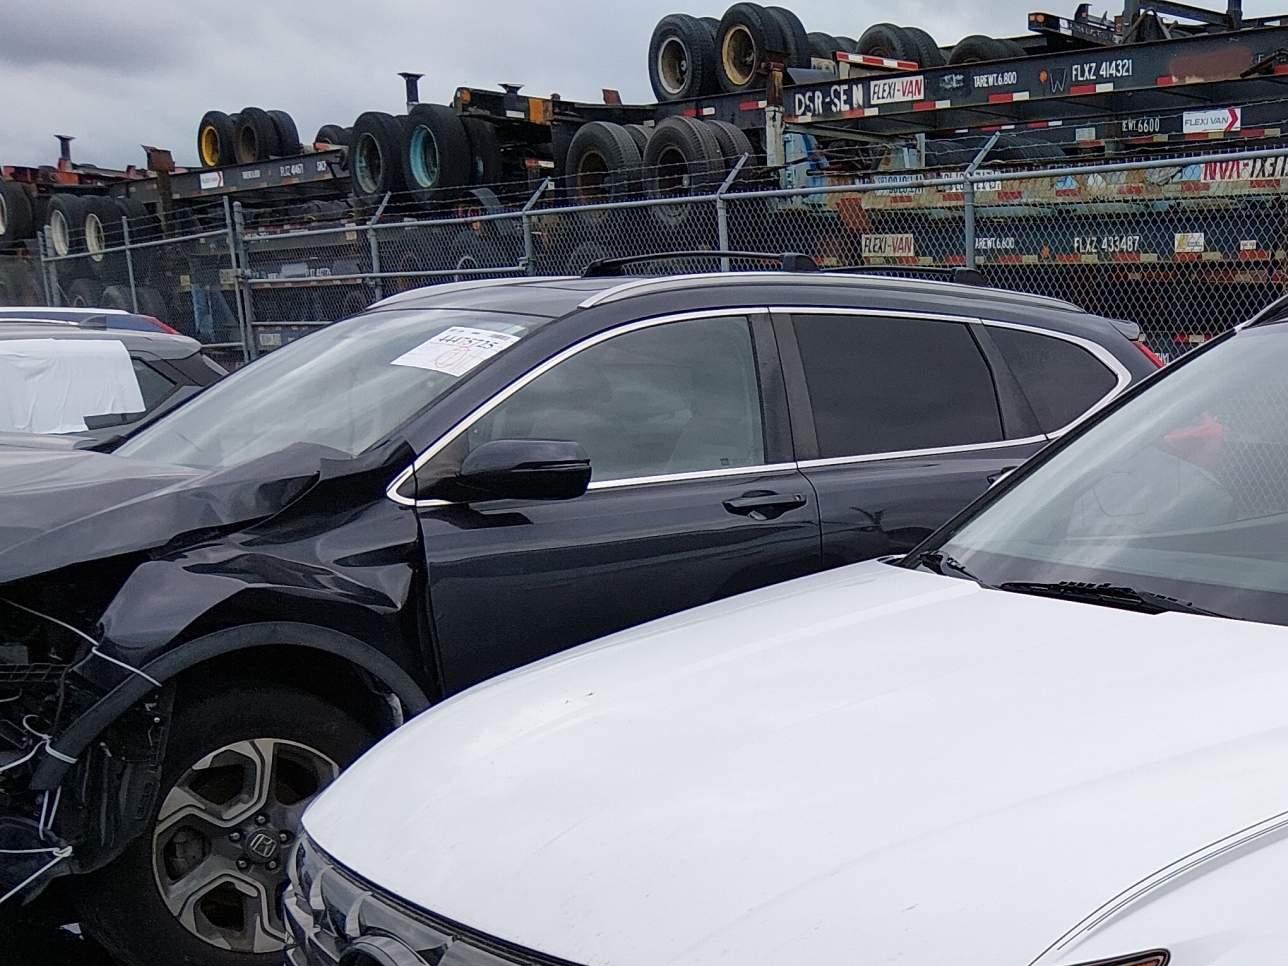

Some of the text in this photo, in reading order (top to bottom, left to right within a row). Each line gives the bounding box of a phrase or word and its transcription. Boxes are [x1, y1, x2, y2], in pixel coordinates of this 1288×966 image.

[1072, 59, 1132, 81] FLXZ 414321
[872, 79, 923, 100] FLEXI-VAN
[1184, 116, 1229, 127] FLEXI VAN
[1074, 235, 1140, 252] FLXZ 433487
